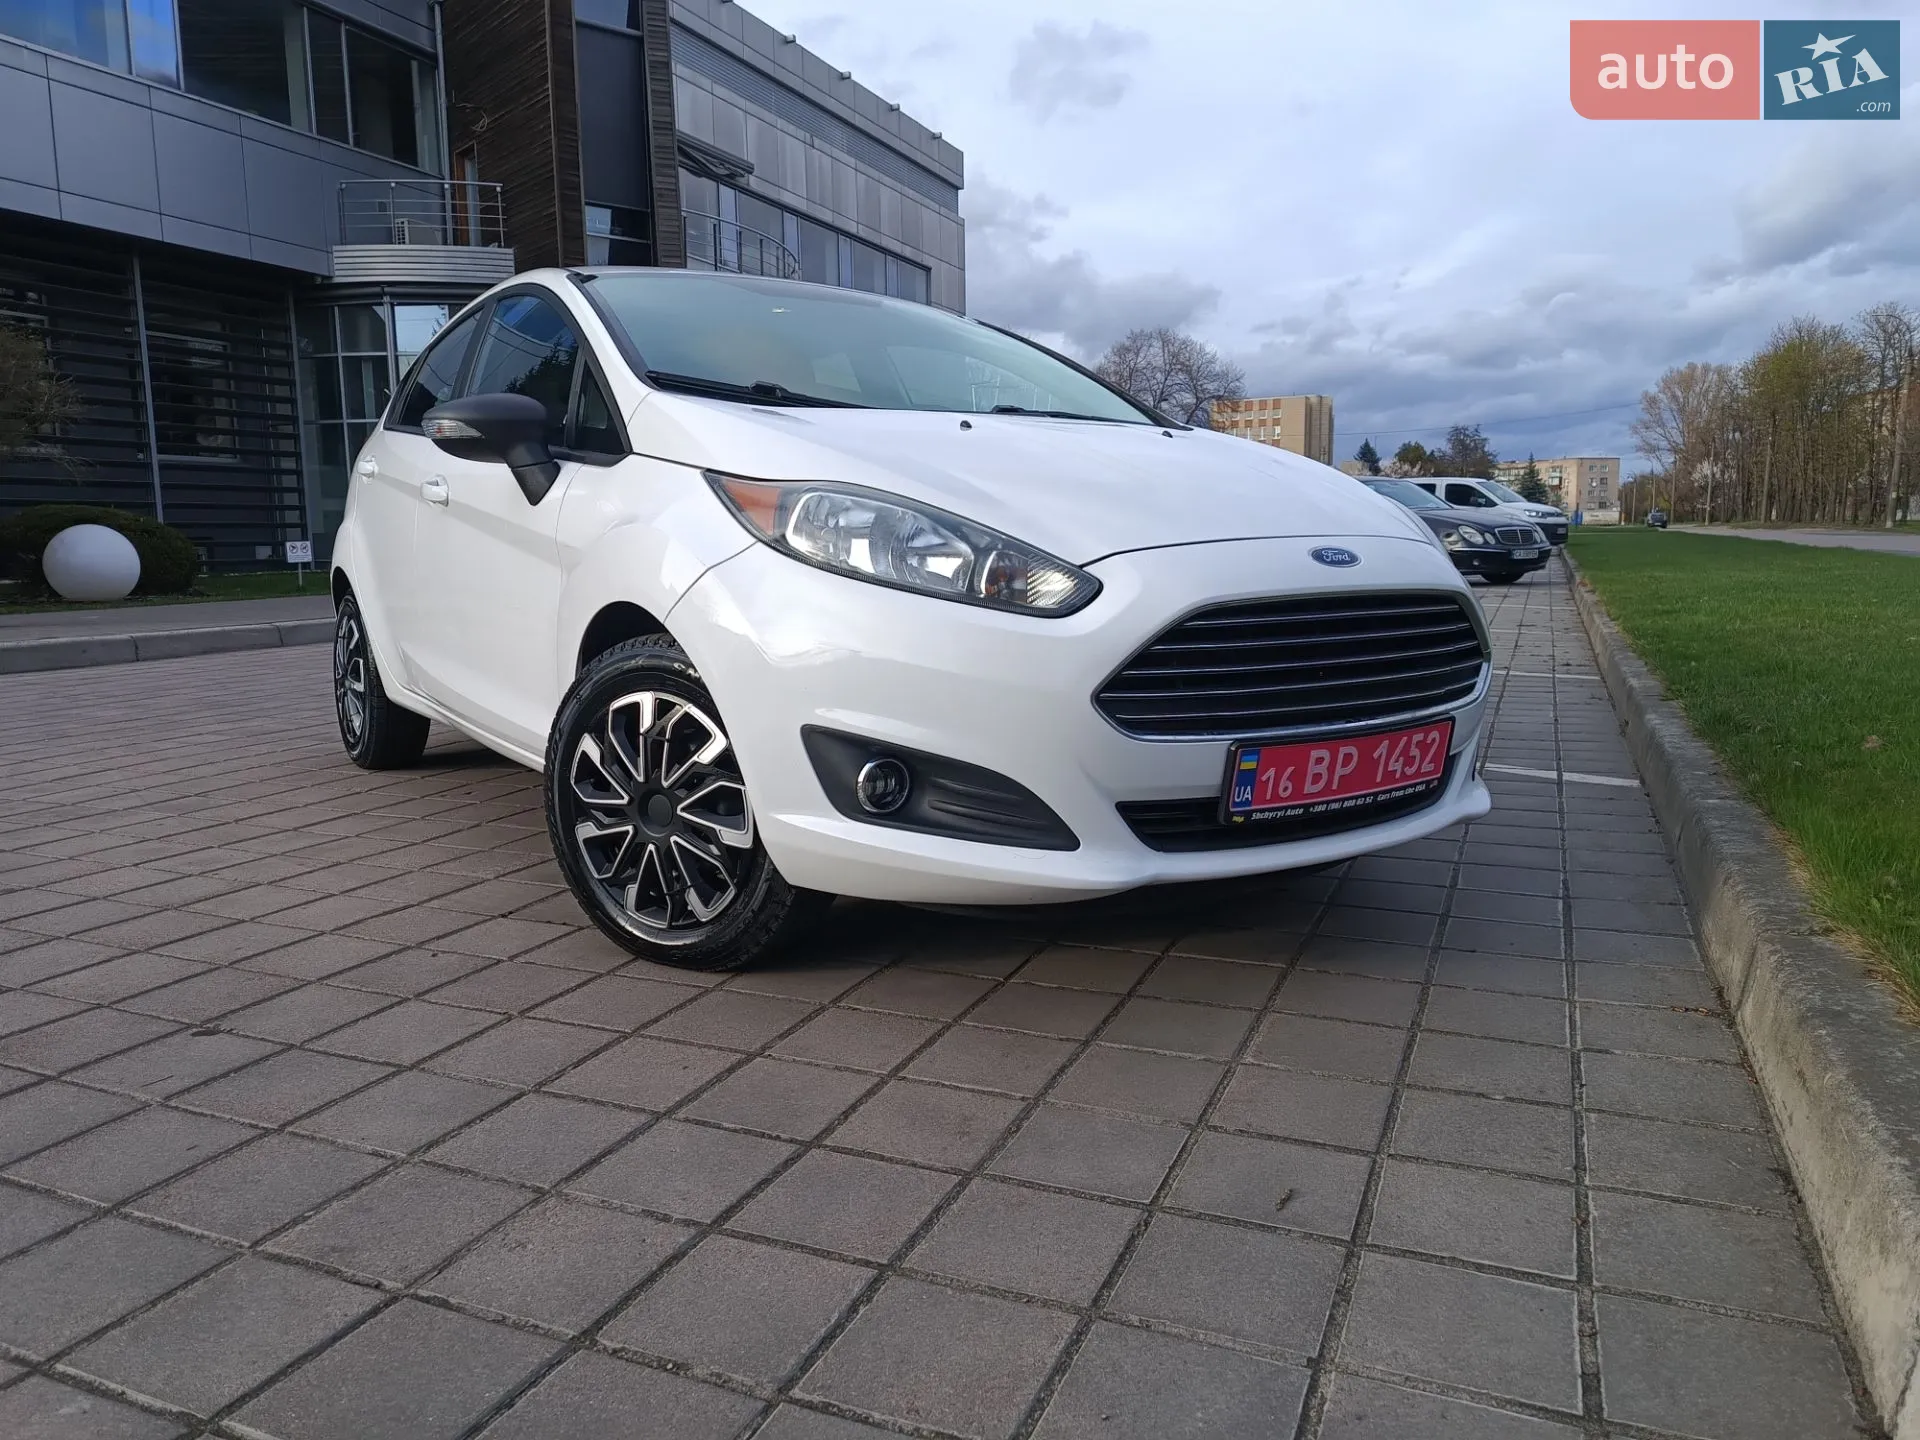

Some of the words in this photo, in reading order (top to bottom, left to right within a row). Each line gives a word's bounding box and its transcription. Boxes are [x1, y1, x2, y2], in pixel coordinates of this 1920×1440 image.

[1322, 550, 1350, 561] Ford
[1260, 766, 1296, 800] 16
[1303, 746, 1359, 794] BP
[1372, 730, 1441, 783] 1452
[1234, 785, 1252, 802] UA
[1285, 808, 1304, 816] Auto
